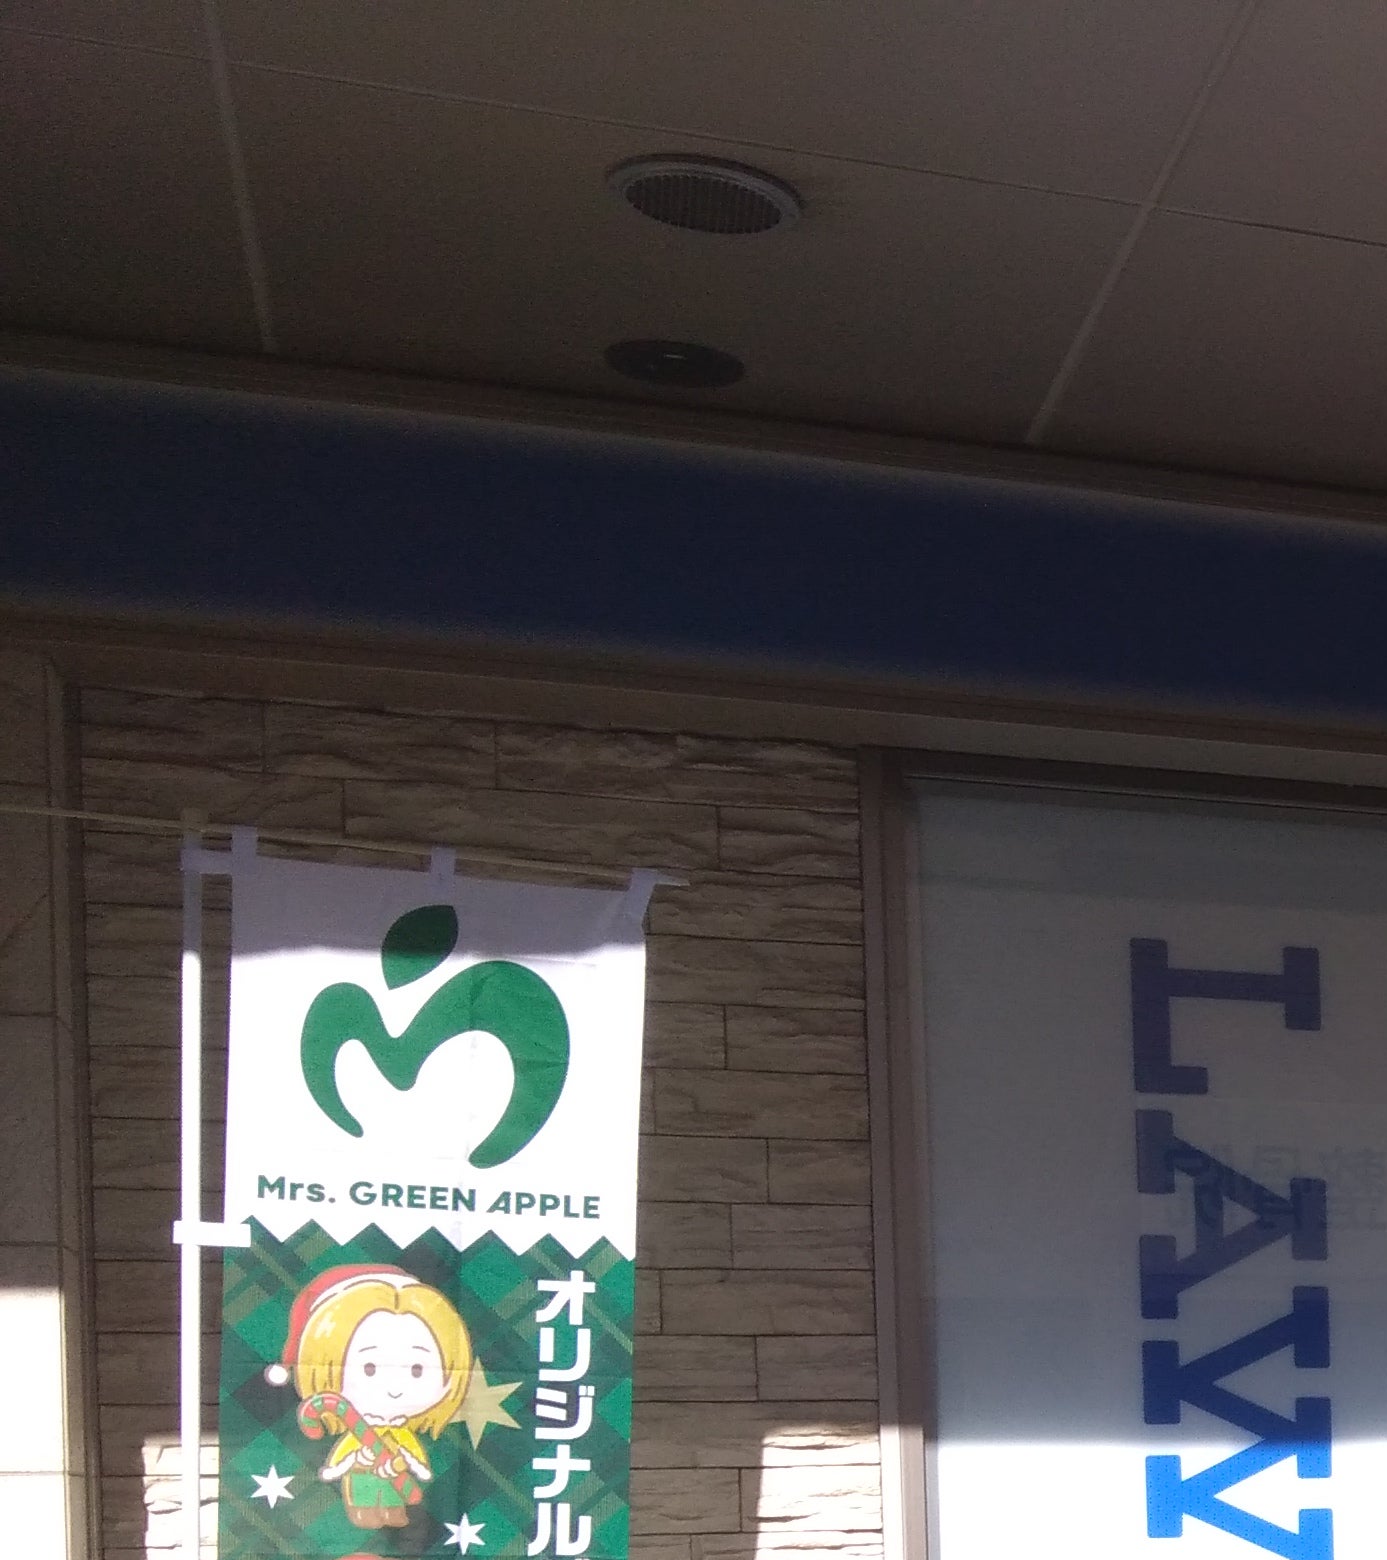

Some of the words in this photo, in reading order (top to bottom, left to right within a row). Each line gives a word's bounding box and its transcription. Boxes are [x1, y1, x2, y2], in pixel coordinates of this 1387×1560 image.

[257, 1175, 336, 1204] Mrs.
[349, 1181, 476, 1212] GREEN
[486, 1191, 601, 1219] APPLE
